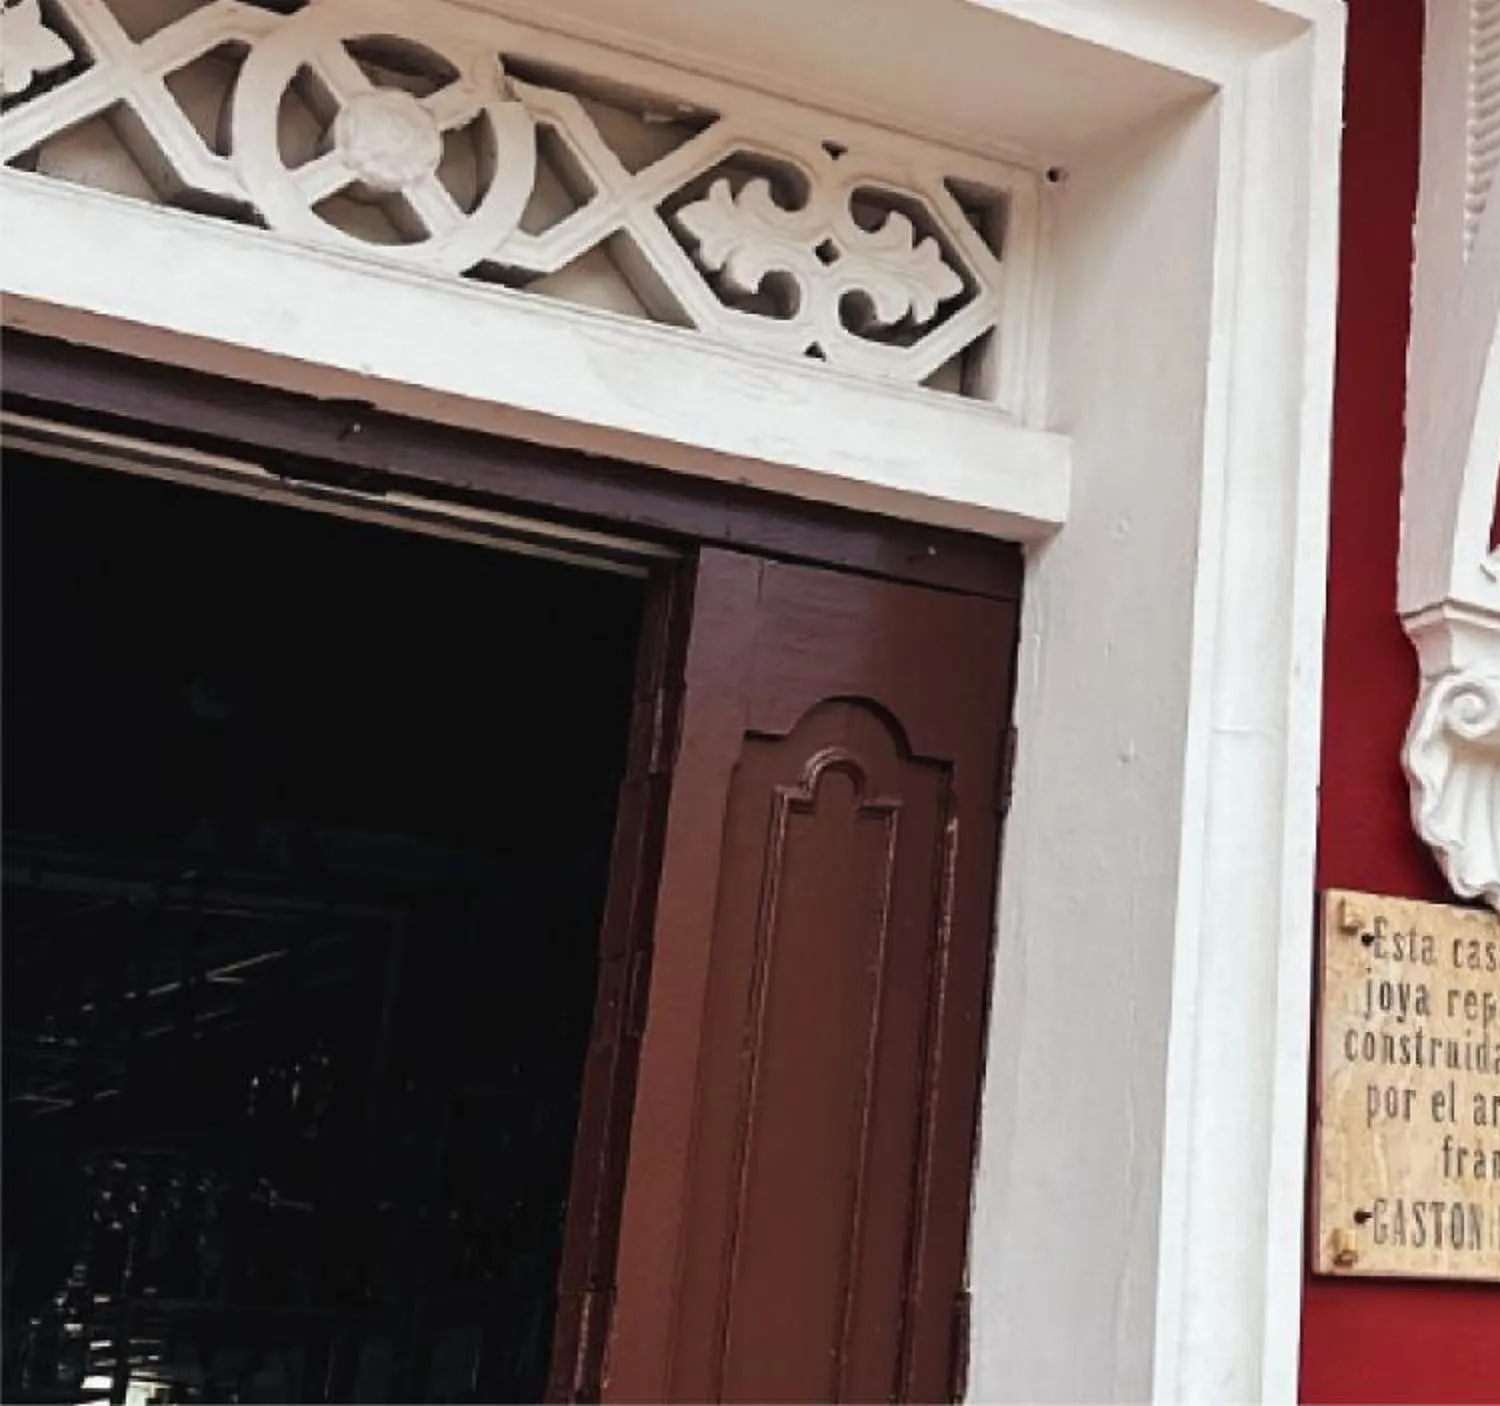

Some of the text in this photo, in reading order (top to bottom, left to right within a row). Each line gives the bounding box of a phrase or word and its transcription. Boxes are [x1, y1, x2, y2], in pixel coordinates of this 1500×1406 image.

[1374, 915, 1436, 966] Esta
[1364, 966, 1430, 1023] joya
[1366, 1083, 1416, 1129] por
[1431, 1079, 1456, 1123] el
[1373, 1198, 1485, 1252] GASTON
